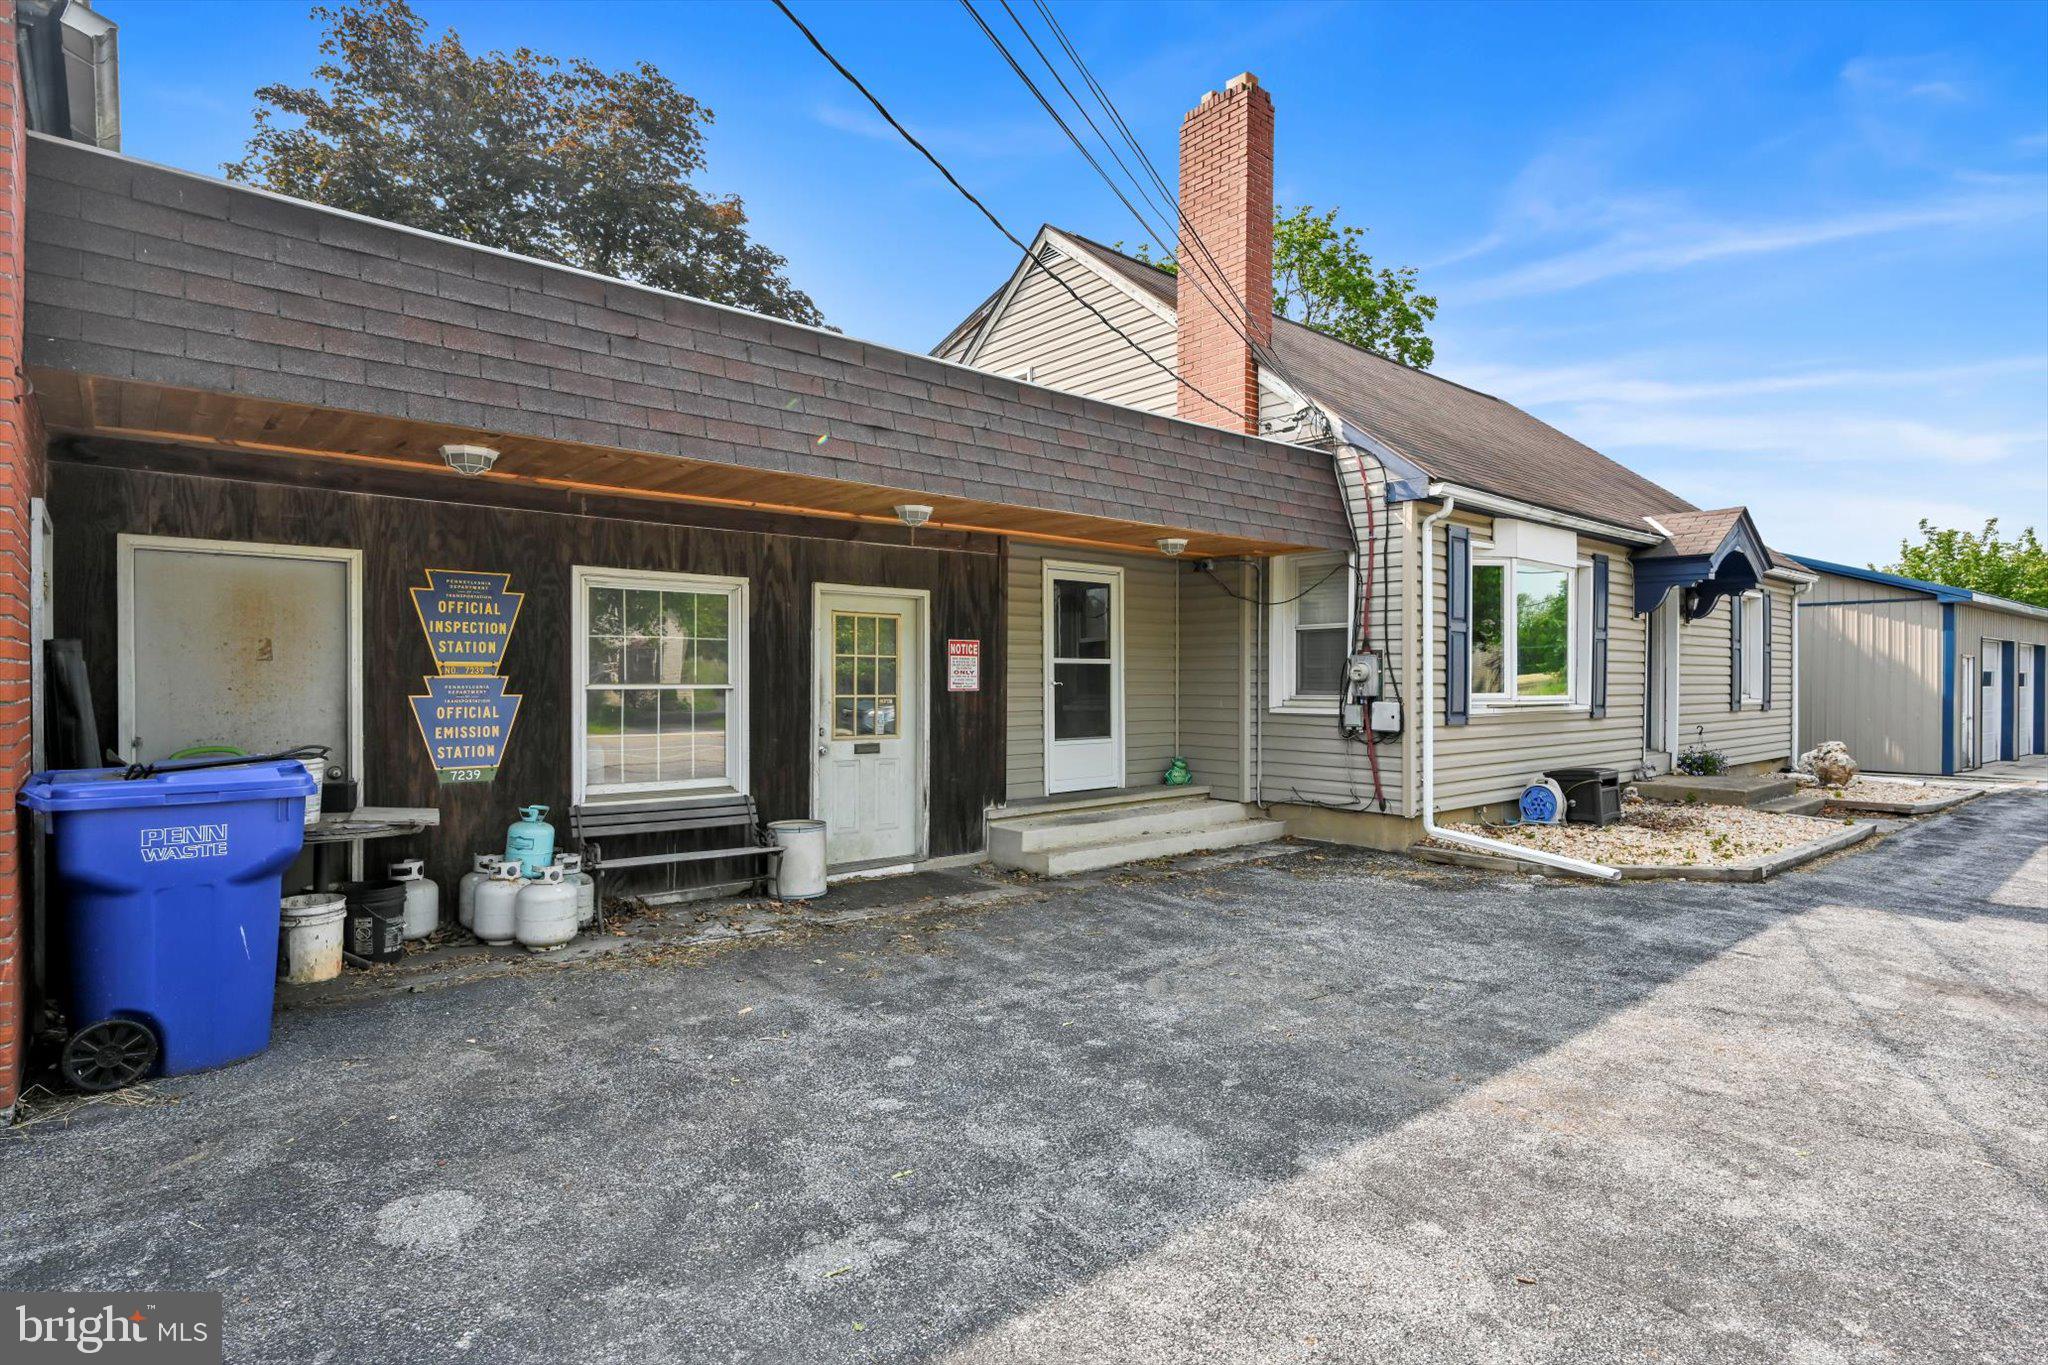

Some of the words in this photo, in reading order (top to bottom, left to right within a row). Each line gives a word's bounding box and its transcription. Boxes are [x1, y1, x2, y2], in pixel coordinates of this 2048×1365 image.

[438, 600, 501, 615] OFFICIAL
[429, 620, 507, 635] INSPECTION
[438, 640, 497, 654] STATION
[950, 643, 978, 655] NOTICE
[465, 666, 485, 675] 7239
[436, 706, 500, 719] OFFICIAL
[435, 725, 500, 739] EMISSION
[437, 745, 495, 759] STATION
[451, 770, 481, 781] 7239
[141, 823, 228, 847] PENN
[141, 841, 228, 862] WASTE
